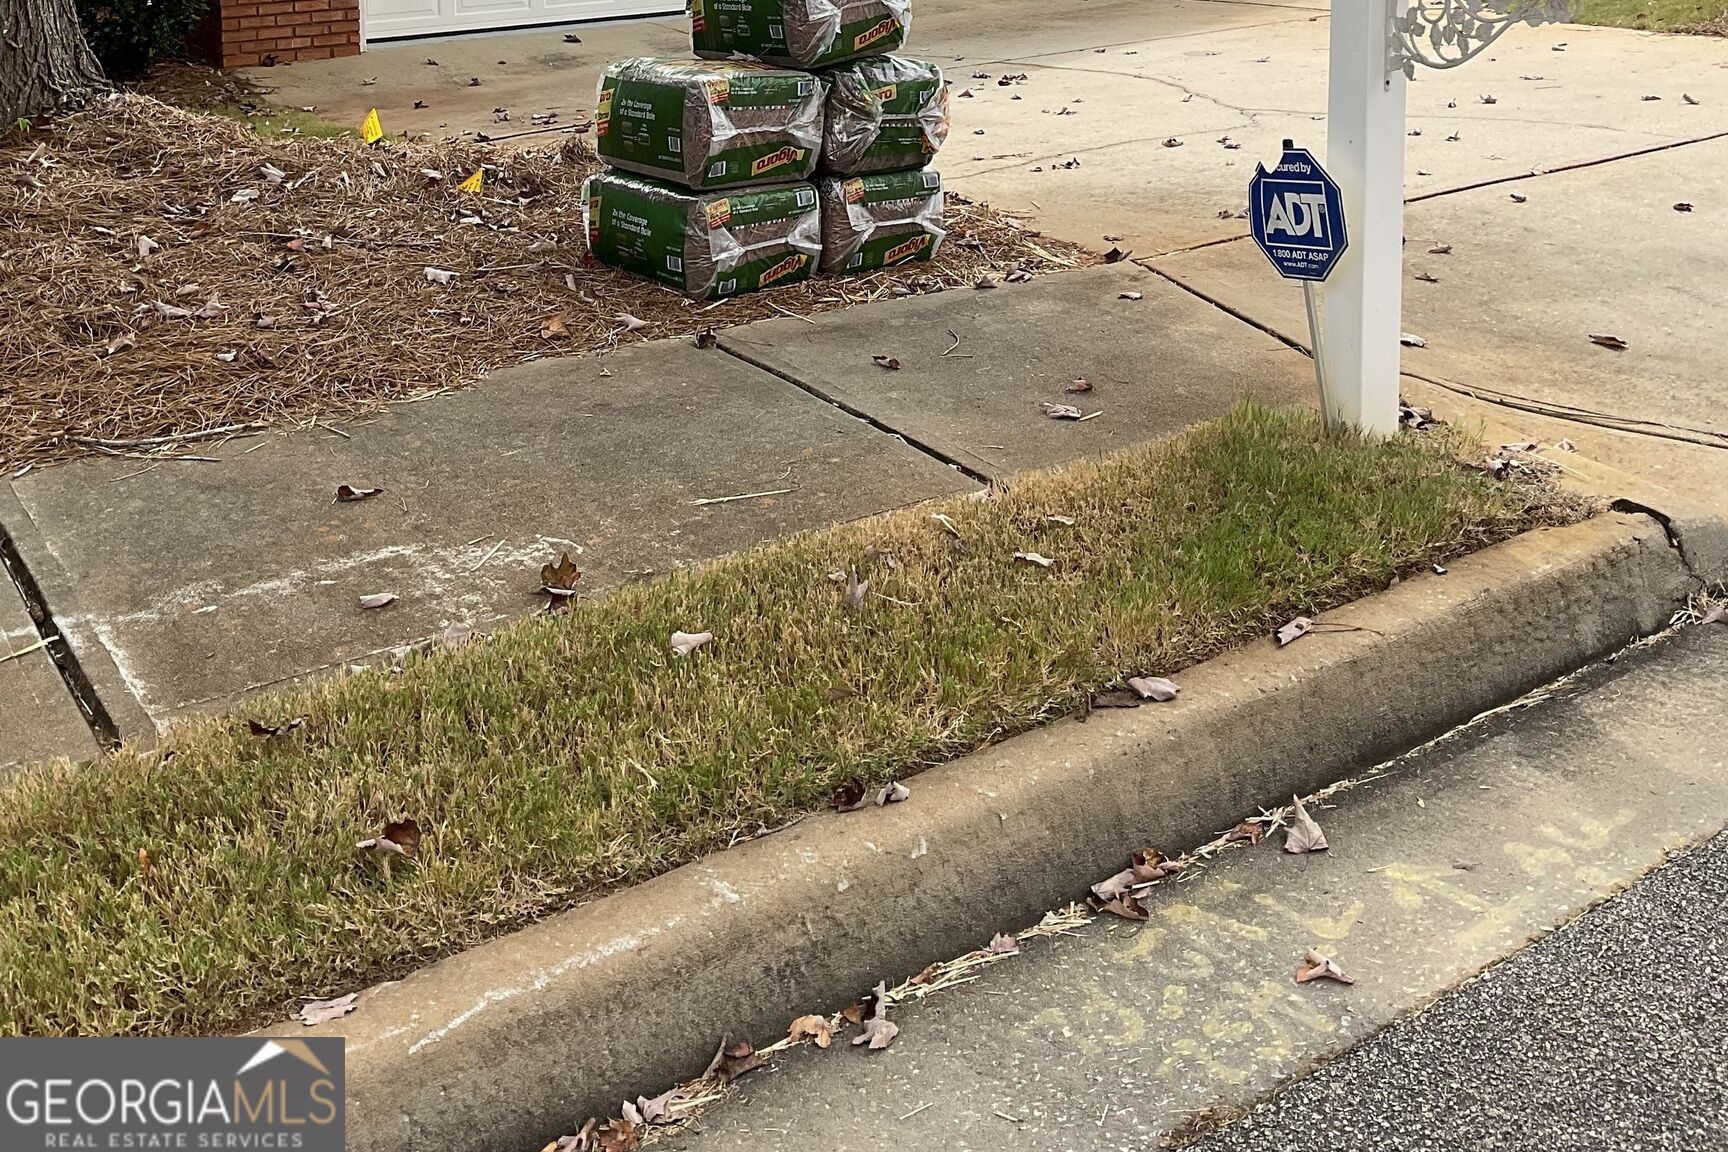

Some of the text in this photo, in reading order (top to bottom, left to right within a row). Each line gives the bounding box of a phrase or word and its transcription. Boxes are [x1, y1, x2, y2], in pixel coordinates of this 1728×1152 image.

[858, 18, 896, 45] Vigoro
[756, 148, 798, 171] Vigoro
[1276, 162, 1311, 175] cured by
[620, 220, 640, 233] Standard
[626, 212, 648, 226] Coverage
[1266, 192, 1326, 238] ADT
[888, 236, 926, 259] Vigoro
[763, 254, 801, 282] Vigoro
